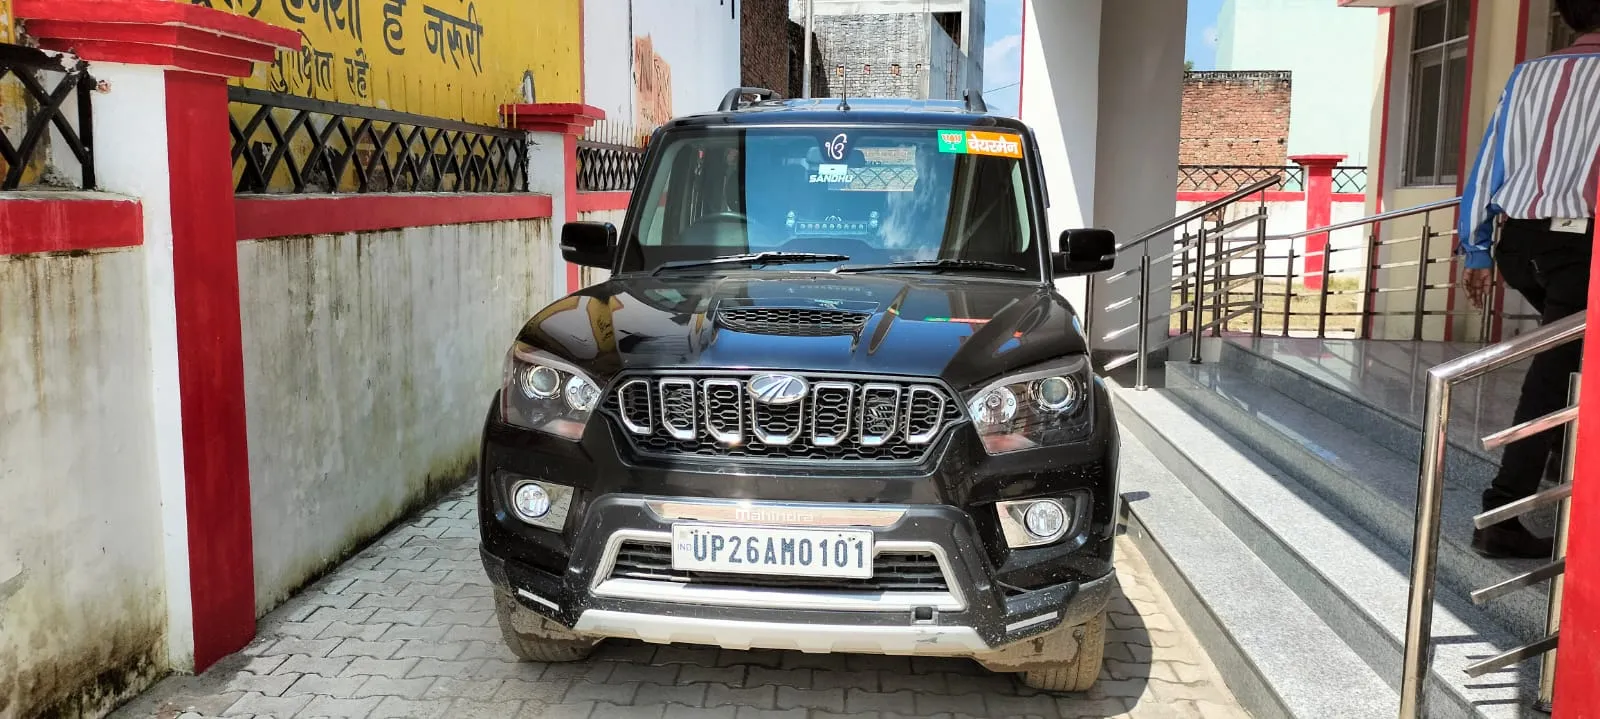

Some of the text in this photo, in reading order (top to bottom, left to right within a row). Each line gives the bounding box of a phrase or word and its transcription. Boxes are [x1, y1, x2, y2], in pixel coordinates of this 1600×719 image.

[967, 131, 1019, 155] चेयरमैन
[809, 174, 854, 183] SANDHU
[693, 534, 864, 569] UP26AM0101
